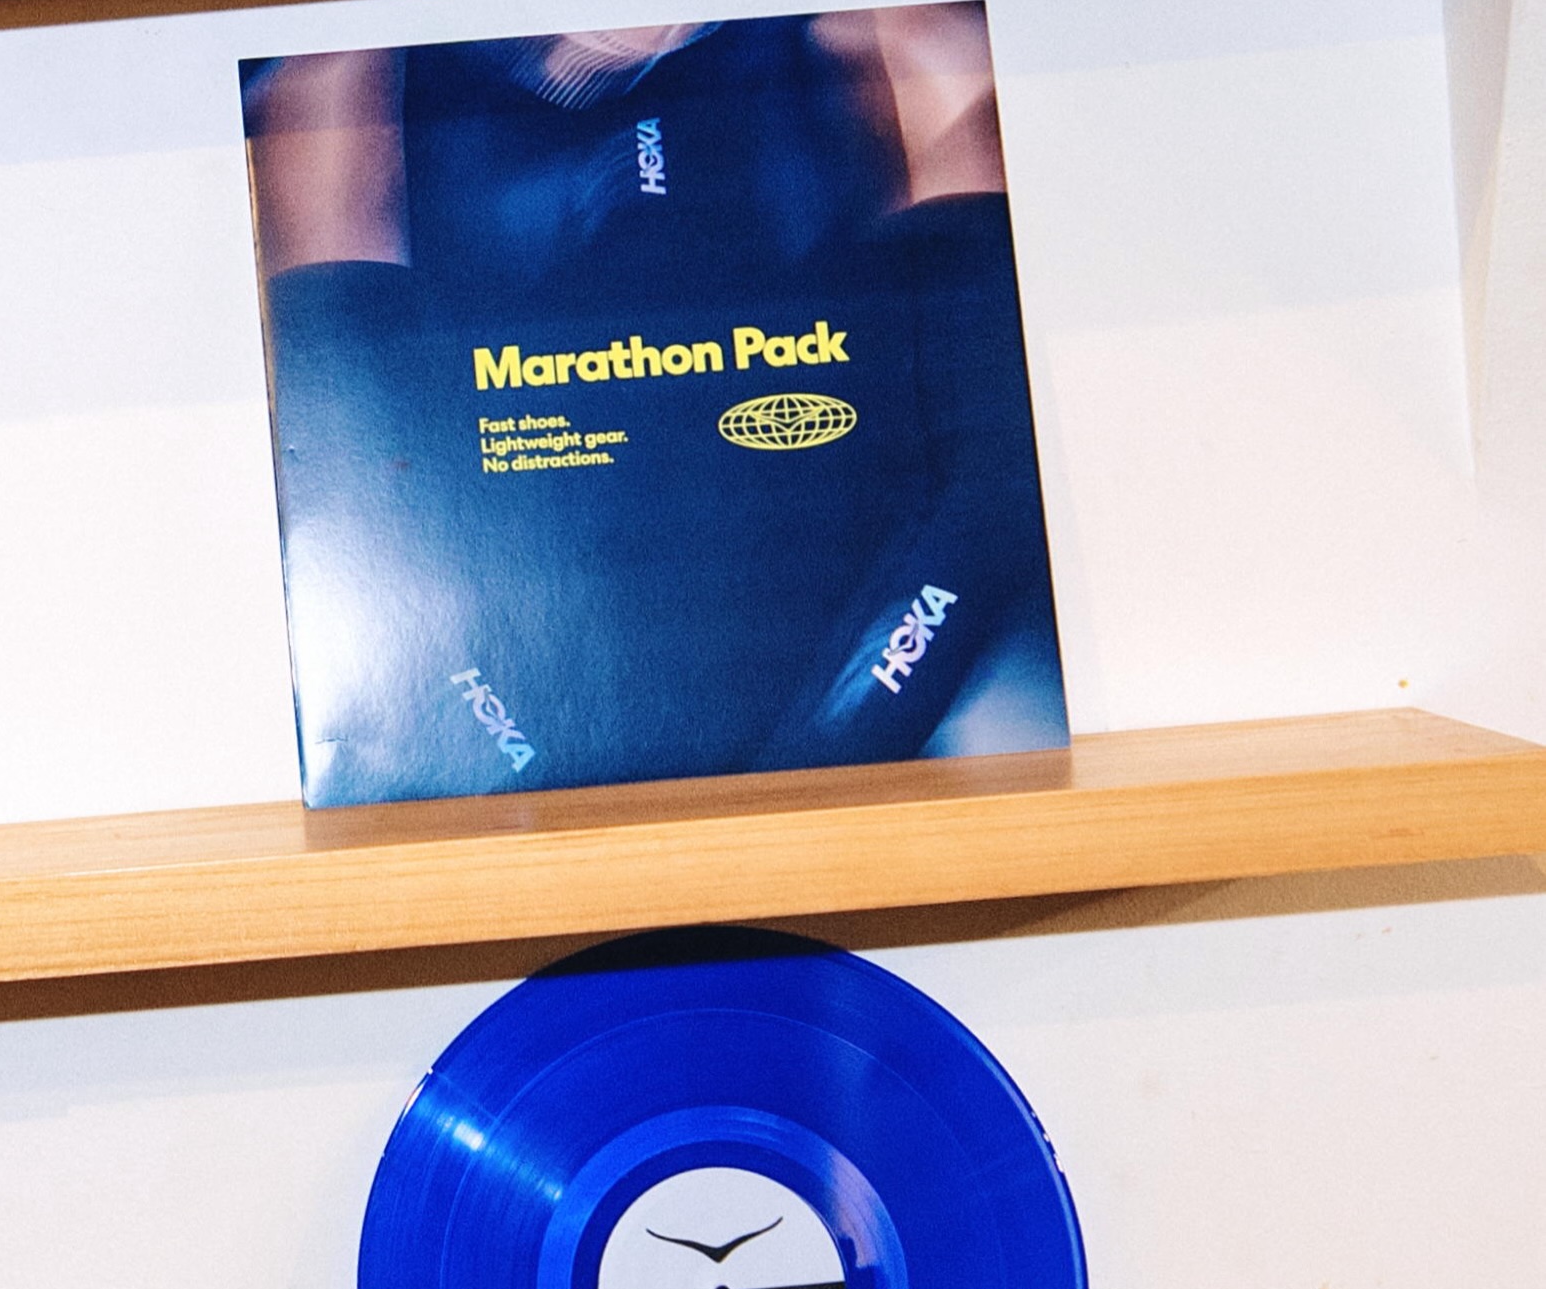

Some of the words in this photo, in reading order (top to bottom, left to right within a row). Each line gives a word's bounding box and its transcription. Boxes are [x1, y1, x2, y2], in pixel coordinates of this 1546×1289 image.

[637, 117, 667, 195] HOKA
[473, 335, 724, 391] Marathon
[732, 320, 850, 370] Pack
[479, 417, 516, 434] Fast
[518, 414, 571, 431] shoes.
[480, 431, 582, 456] Lightweight
[584, 430, 629, 449] gear.
[482, 457, 510, 473] No
[511, 450, 615, 471] distractions.
[871, 584, 959, 694] HOKA
[450, 667, 536, 773] HOKA
